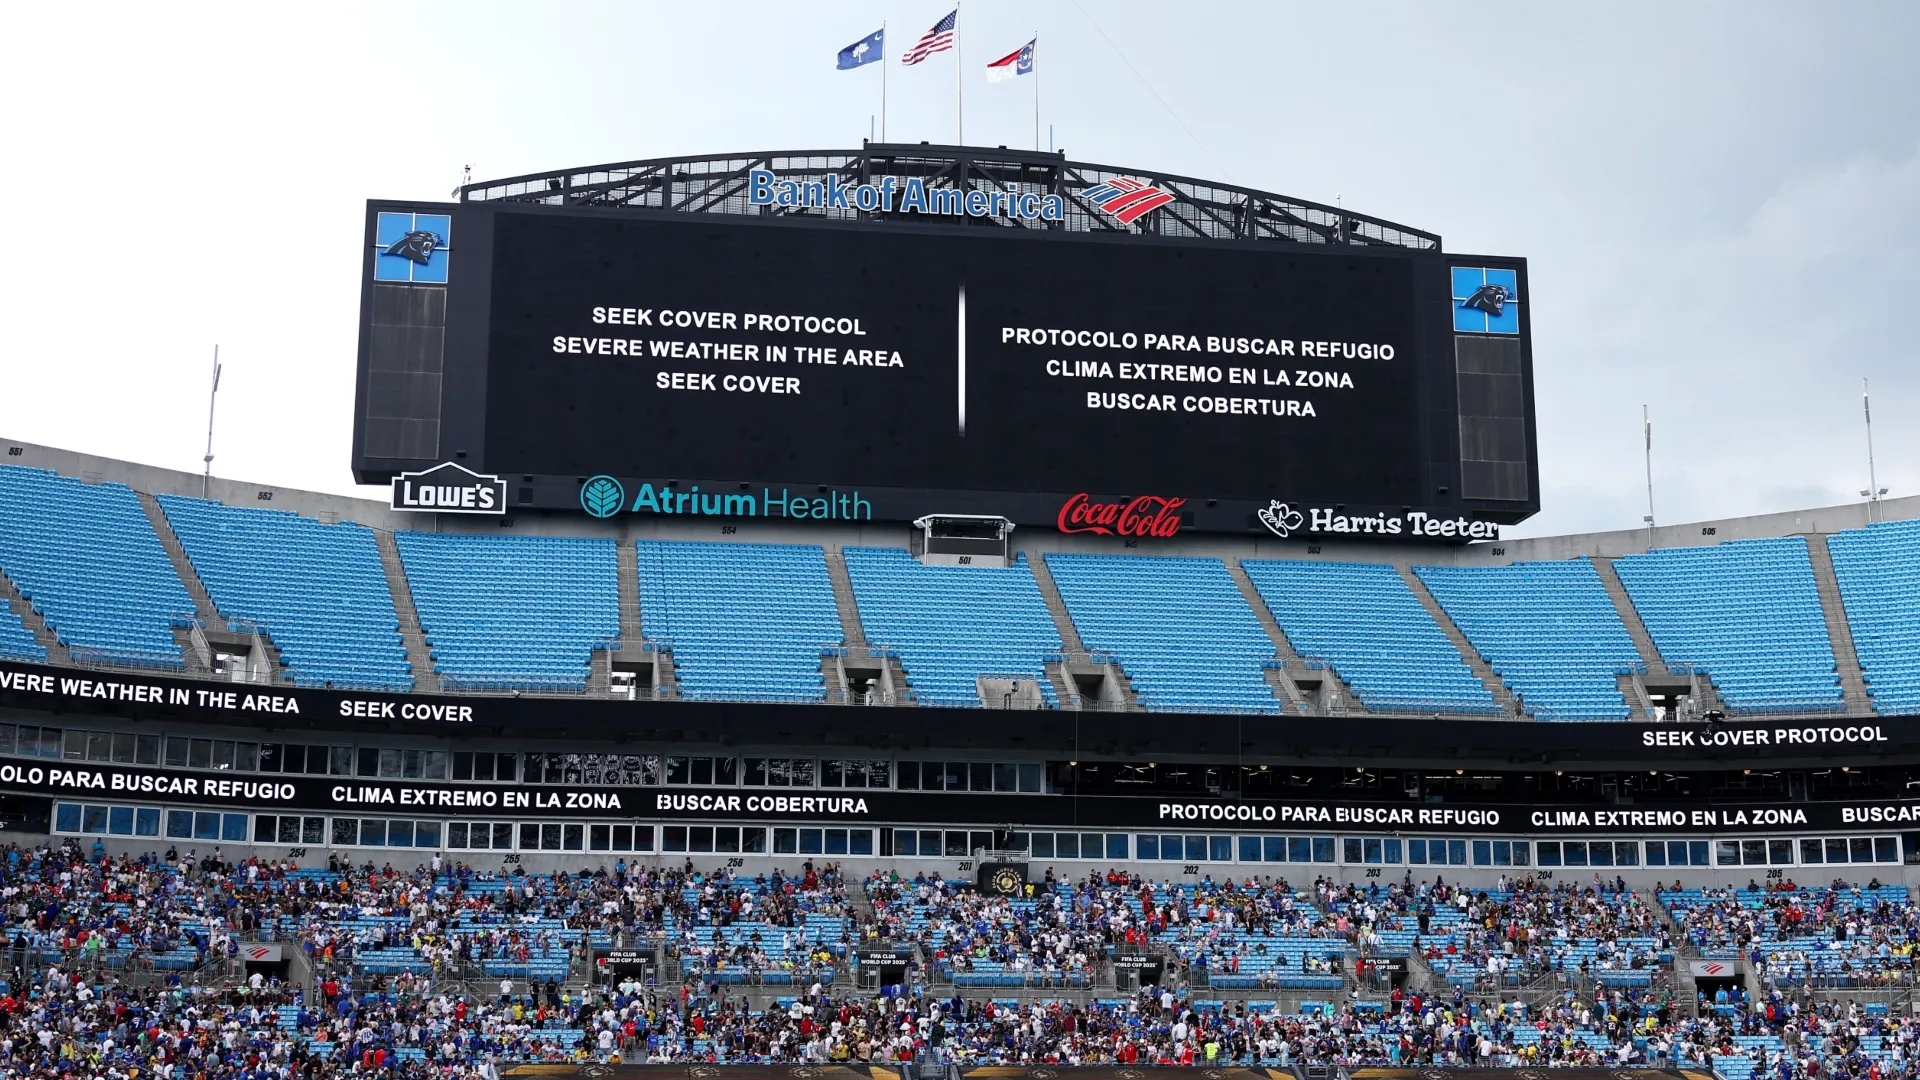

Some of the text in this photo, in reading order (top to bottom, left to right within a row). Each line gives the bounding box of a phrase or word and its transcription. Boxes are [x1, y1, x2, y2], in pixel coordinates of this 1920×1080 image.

[749, 169, 1064, 222] Bank of America
[593, 307, 866, 335] SEEK COVER PROTOCOL
[553, 336, 903, 367] SEVERE WEATHER IN THE AREA
[1003, 328, 1394, 360] PROTOCOLO PARA BUSCAR REFUGIO
[657, 372, 800, 394] SEEK COVER
[1047, 360, 1354, 388] CLIMA EXTREMO EN LA ZONA
[1088, 392, 1316, 417] BUSCAR COBERTURA
[8, 446, 23, 457] 551
[257, 491, 273, 501] 552
[402, 480, 496, 509] LOWE'S
[632, 484, 870, 519] Atrium Health
[1058, 493, 1185, 536] Coca-Cola
[1310, 509, 1500, 538] Harris Teeter
[721, 526, 736, 535] 554
[1702, 527, 1716, 536] 505
[1308, 546, 1321, 555] 503
[1492, 548, 1505, 557] 504
[958, 556, 971, 565] 501
[61, 675, 162, 703] WEATHER
[170, 689, 189, 705] IN
[197, 691, 236, 709] THE
[242, 695, 299, 713] AREA
[340, 701, 472, 721] SEEK COVER
[1643, 732, 1695, 745] SEEK
[1775, 727, 1887, 743] PROTOCOL
[49, 770, 105, 788] PARA
[112, 774, 197, 794] BUSCAR
[204, 780, 295, 799] REFUGIO
[332, 787, 621, 808] CLIMA EXTREMO EN LA ZONA
[657, 795, 868, 813] BUSCAR COBERTURA
[1160, 804, 1499, 825] PROTOCOLO PARA BUSCAR REFUGIO
[1532, 809, 1807, 826] CLIMA EXTREMO EN LA ZONA
[289, 848, 306, 858] 254
[503, 854, 520, 864] 255
[727, 858, 743, 868] 256
[958, 861, 972, 871] 201
[1183, 865, 1199, 875] 202
[1366, 868, 1381, 878] 203
[1537, 870, 1553, 880] 204
[1767, 869, 1782, 879] 205
